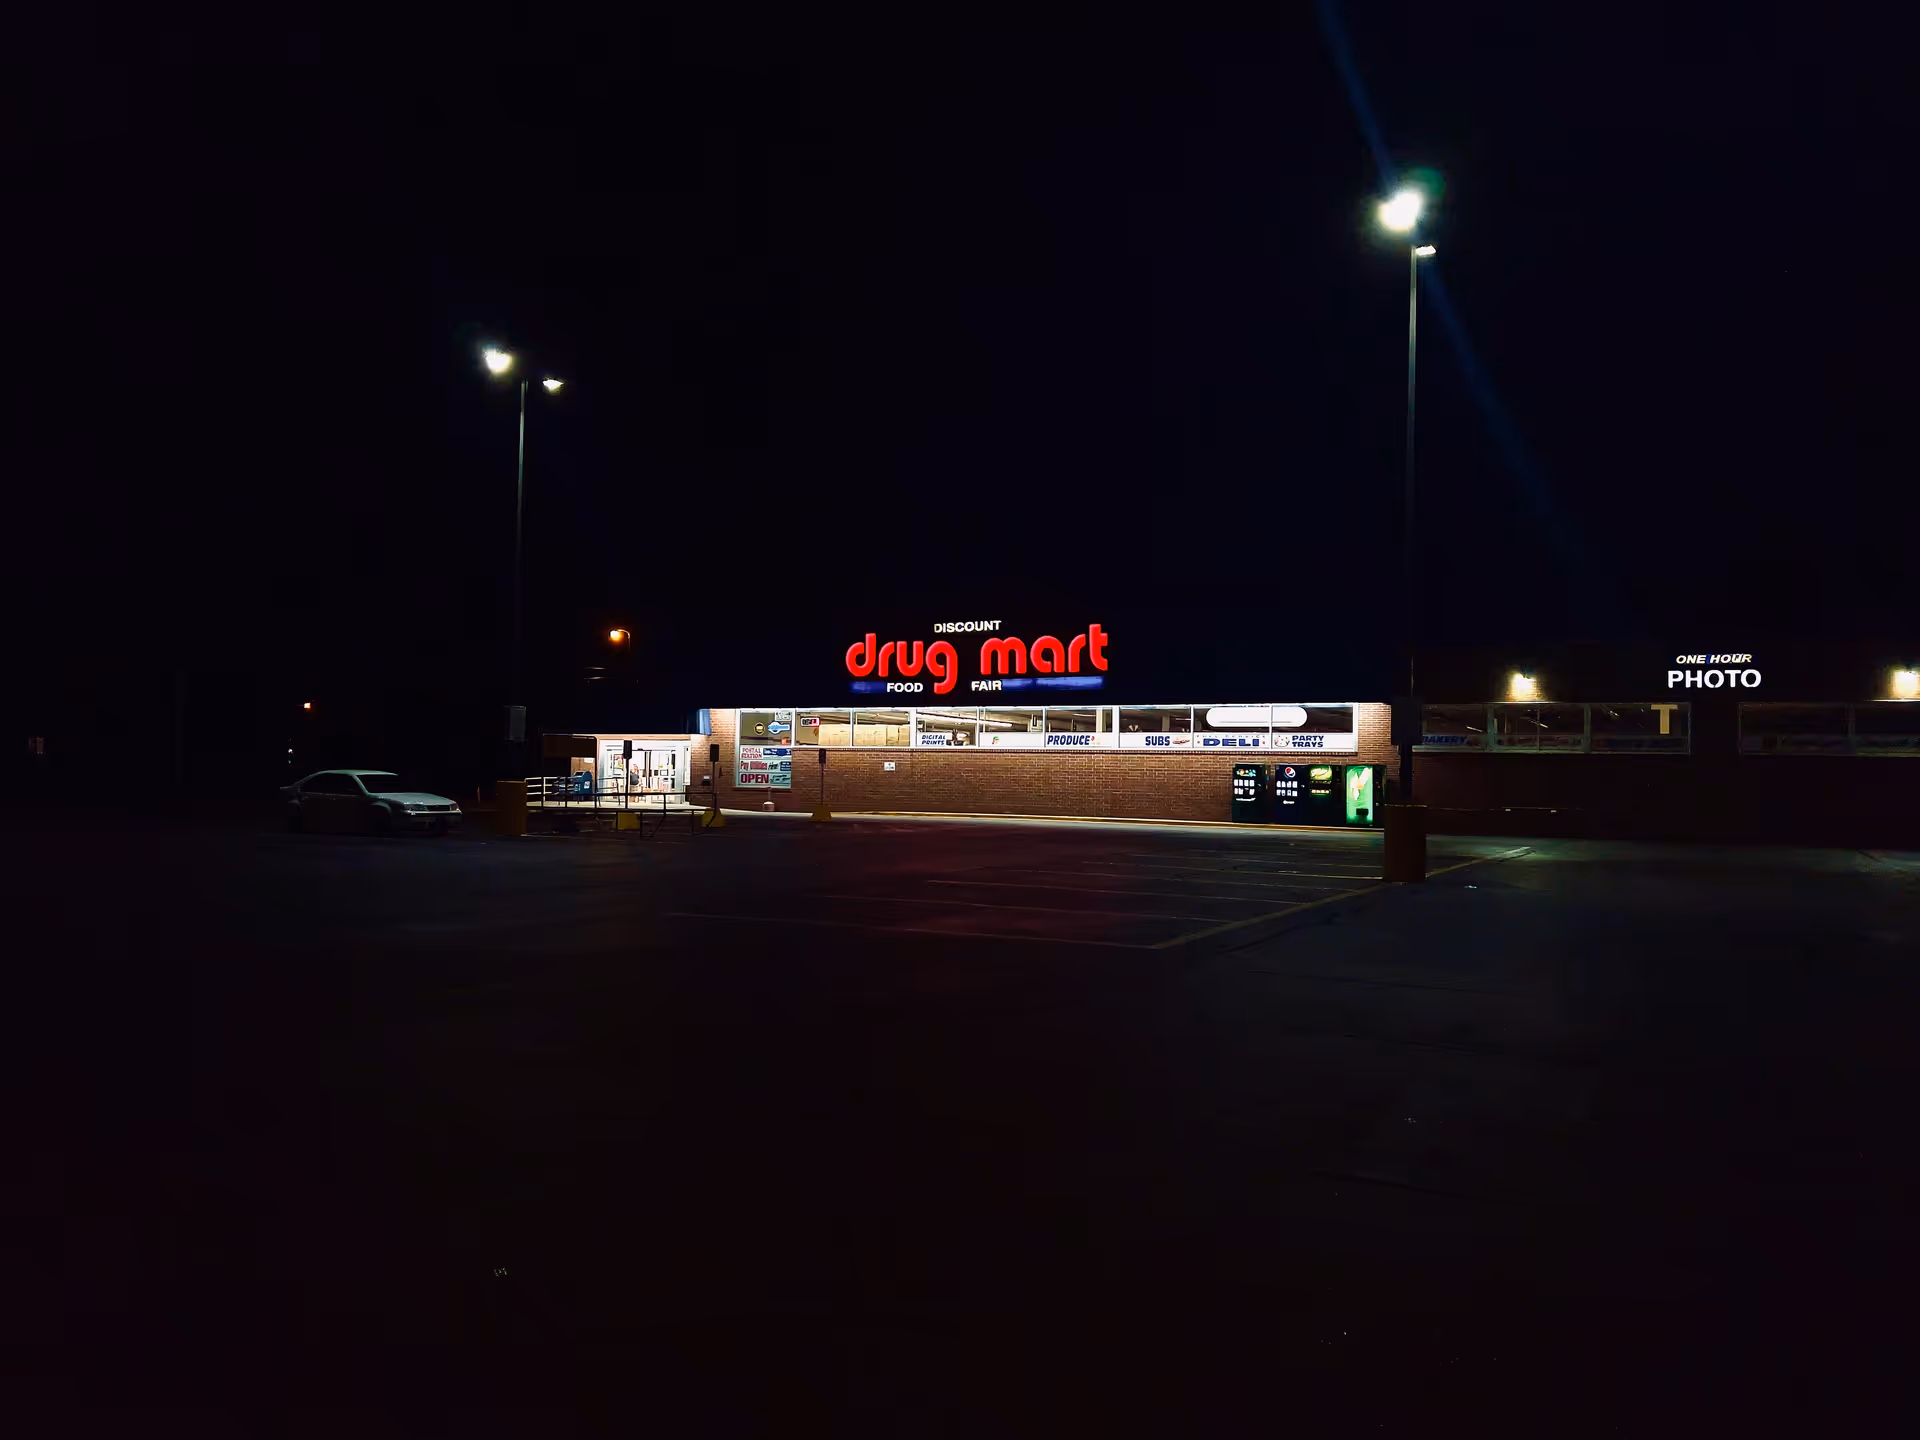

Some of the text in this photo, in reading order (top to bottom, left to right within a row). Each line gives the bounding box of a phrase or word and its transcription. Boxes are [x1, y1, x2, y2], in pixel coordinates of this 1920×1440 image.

[933, 620, 1002, 633] DISCOUNT
[845, 623, 1109, 695] drug mart
[1676, 653, 1752, 664] ONE HOUR
[1667, 669, 1762, 689] PHOTO
[886, 680, 1002, 693] FOOD FAIR
[1047, 735, 1091, 746] PRODUCE
[1145, 735, 1170, 746] SUBS
[1203, 738, 1260, 747] DELI
[740, 773, 769, 784] OPEN
